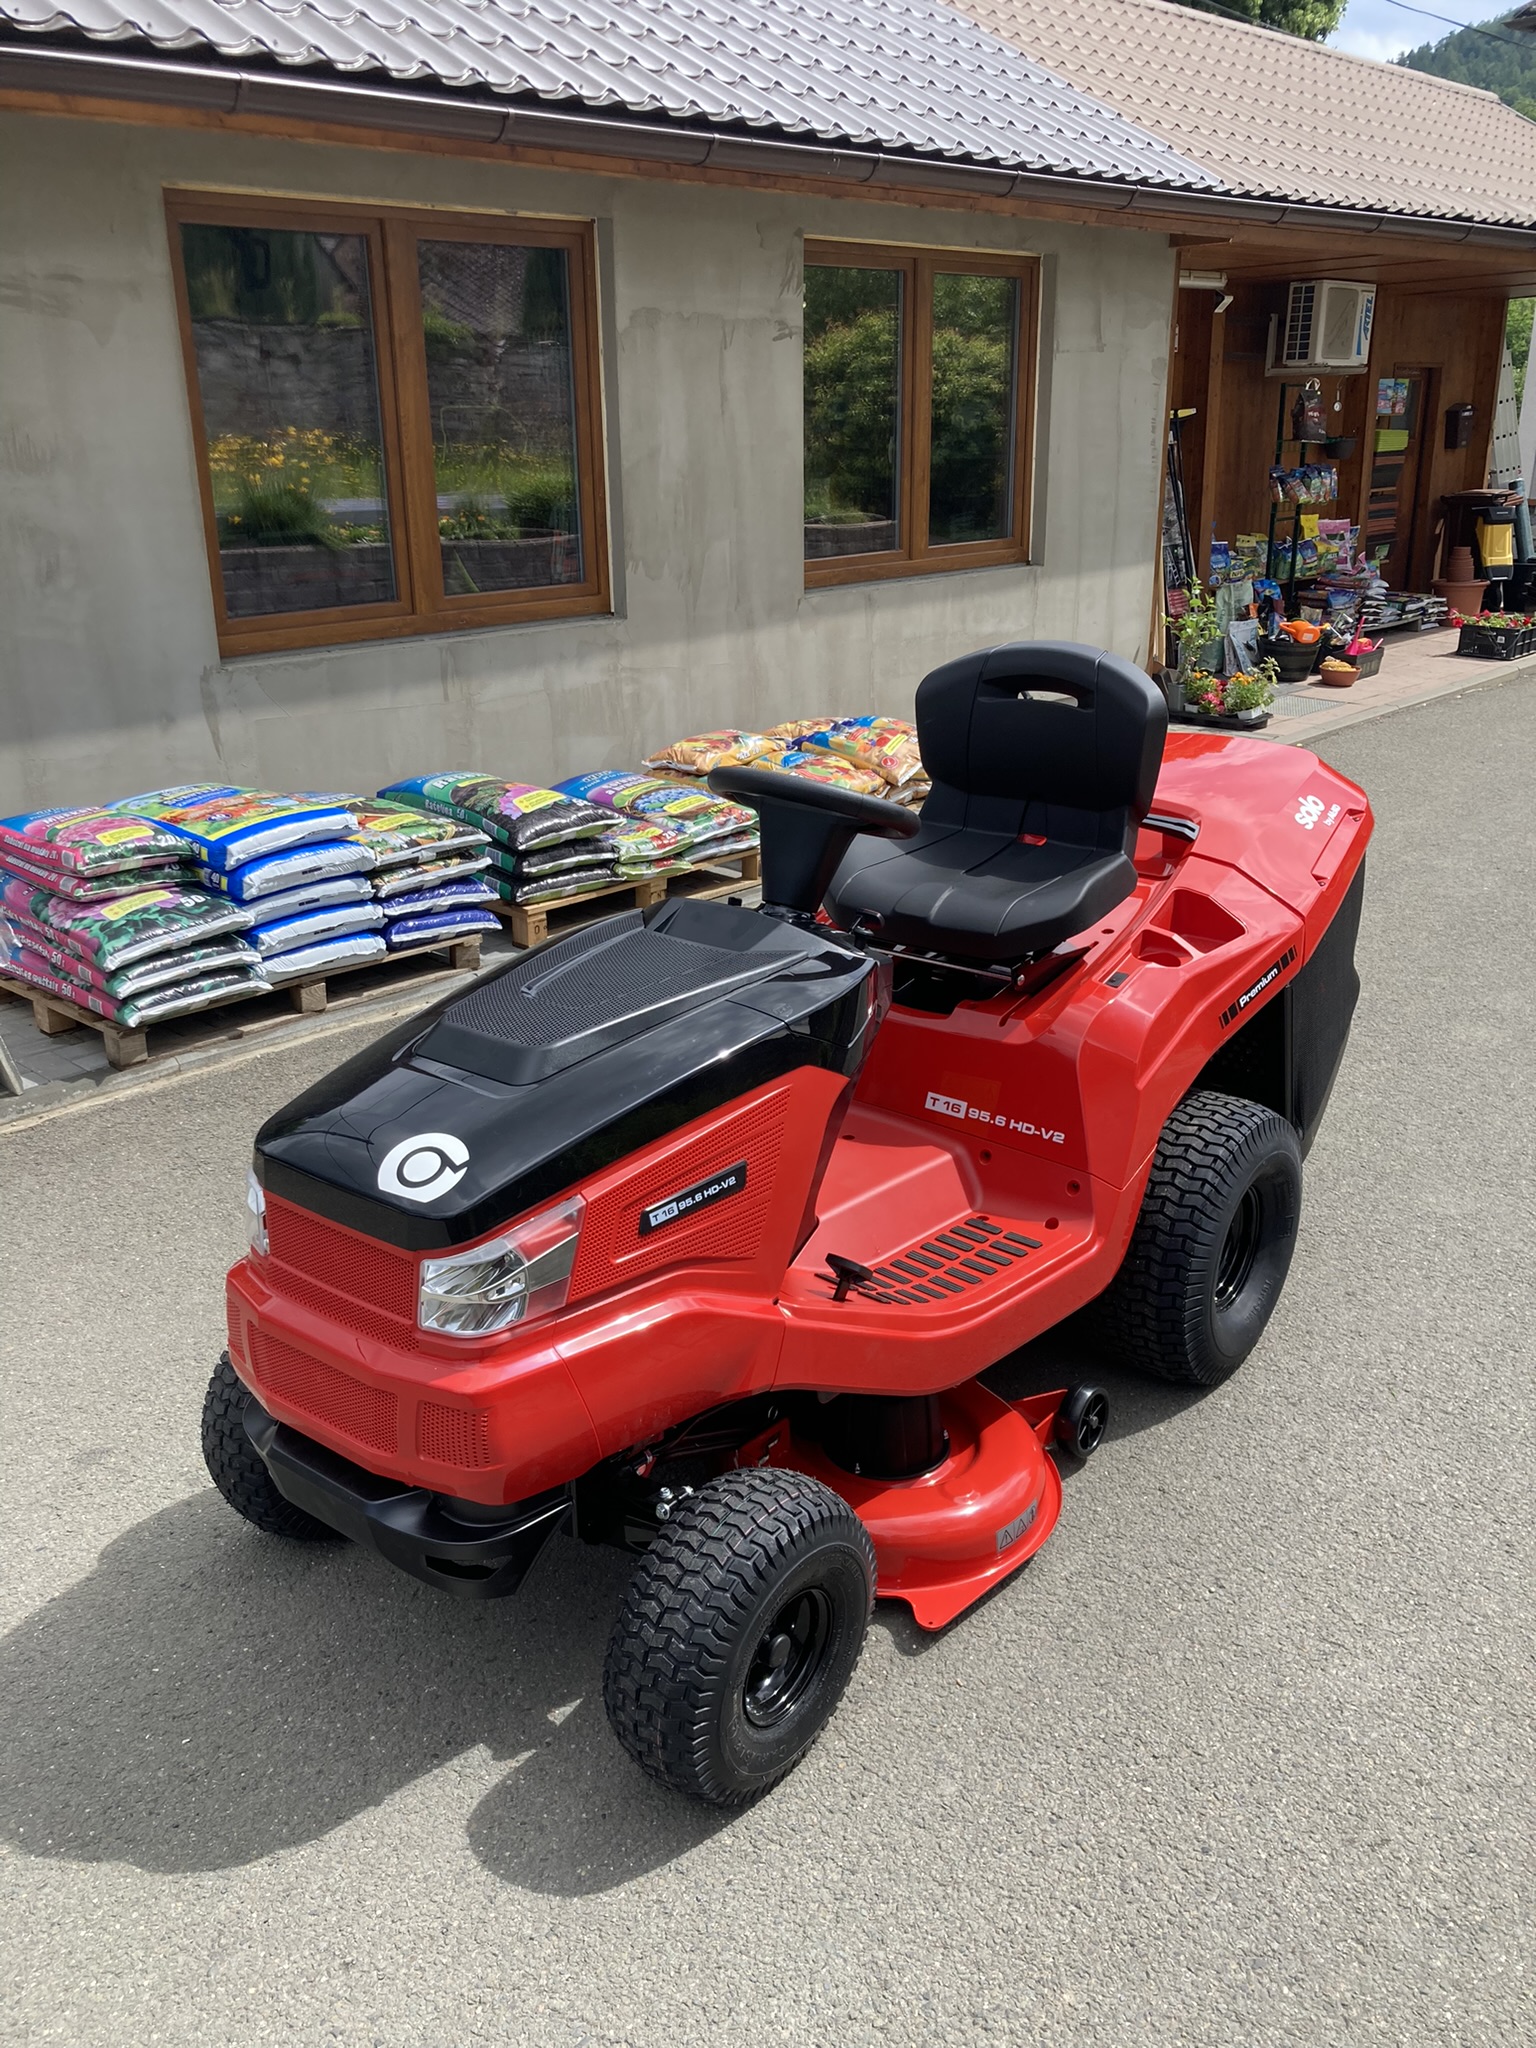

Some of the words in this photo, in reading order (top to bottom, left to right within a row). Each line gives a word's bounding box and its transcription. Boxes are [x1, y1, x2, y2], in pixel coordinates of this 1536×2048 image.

[1295, 795, 1325, 830] solo
[157, 835, 176, 847] 20
[179, 894, 206, 907] 50
[51, 951, 62, 966] 50
[61, 983, 72, 997] 50
[1239, 967, 1278, 1008] Premium
[930, 1096, 940, 1107] T
[943, 1100, 962, 1114] 16
[968, 1107, 1007, 1127] 95.6
[1009, 1119, 1066, 1144] HD-V2
[652, 1213, 660, 1222] T
[661, 1206, 675, 1217] 16
[678, 1193, 703, 1211] 95.6
[703, 1176, 737, 1199] HD-V2
